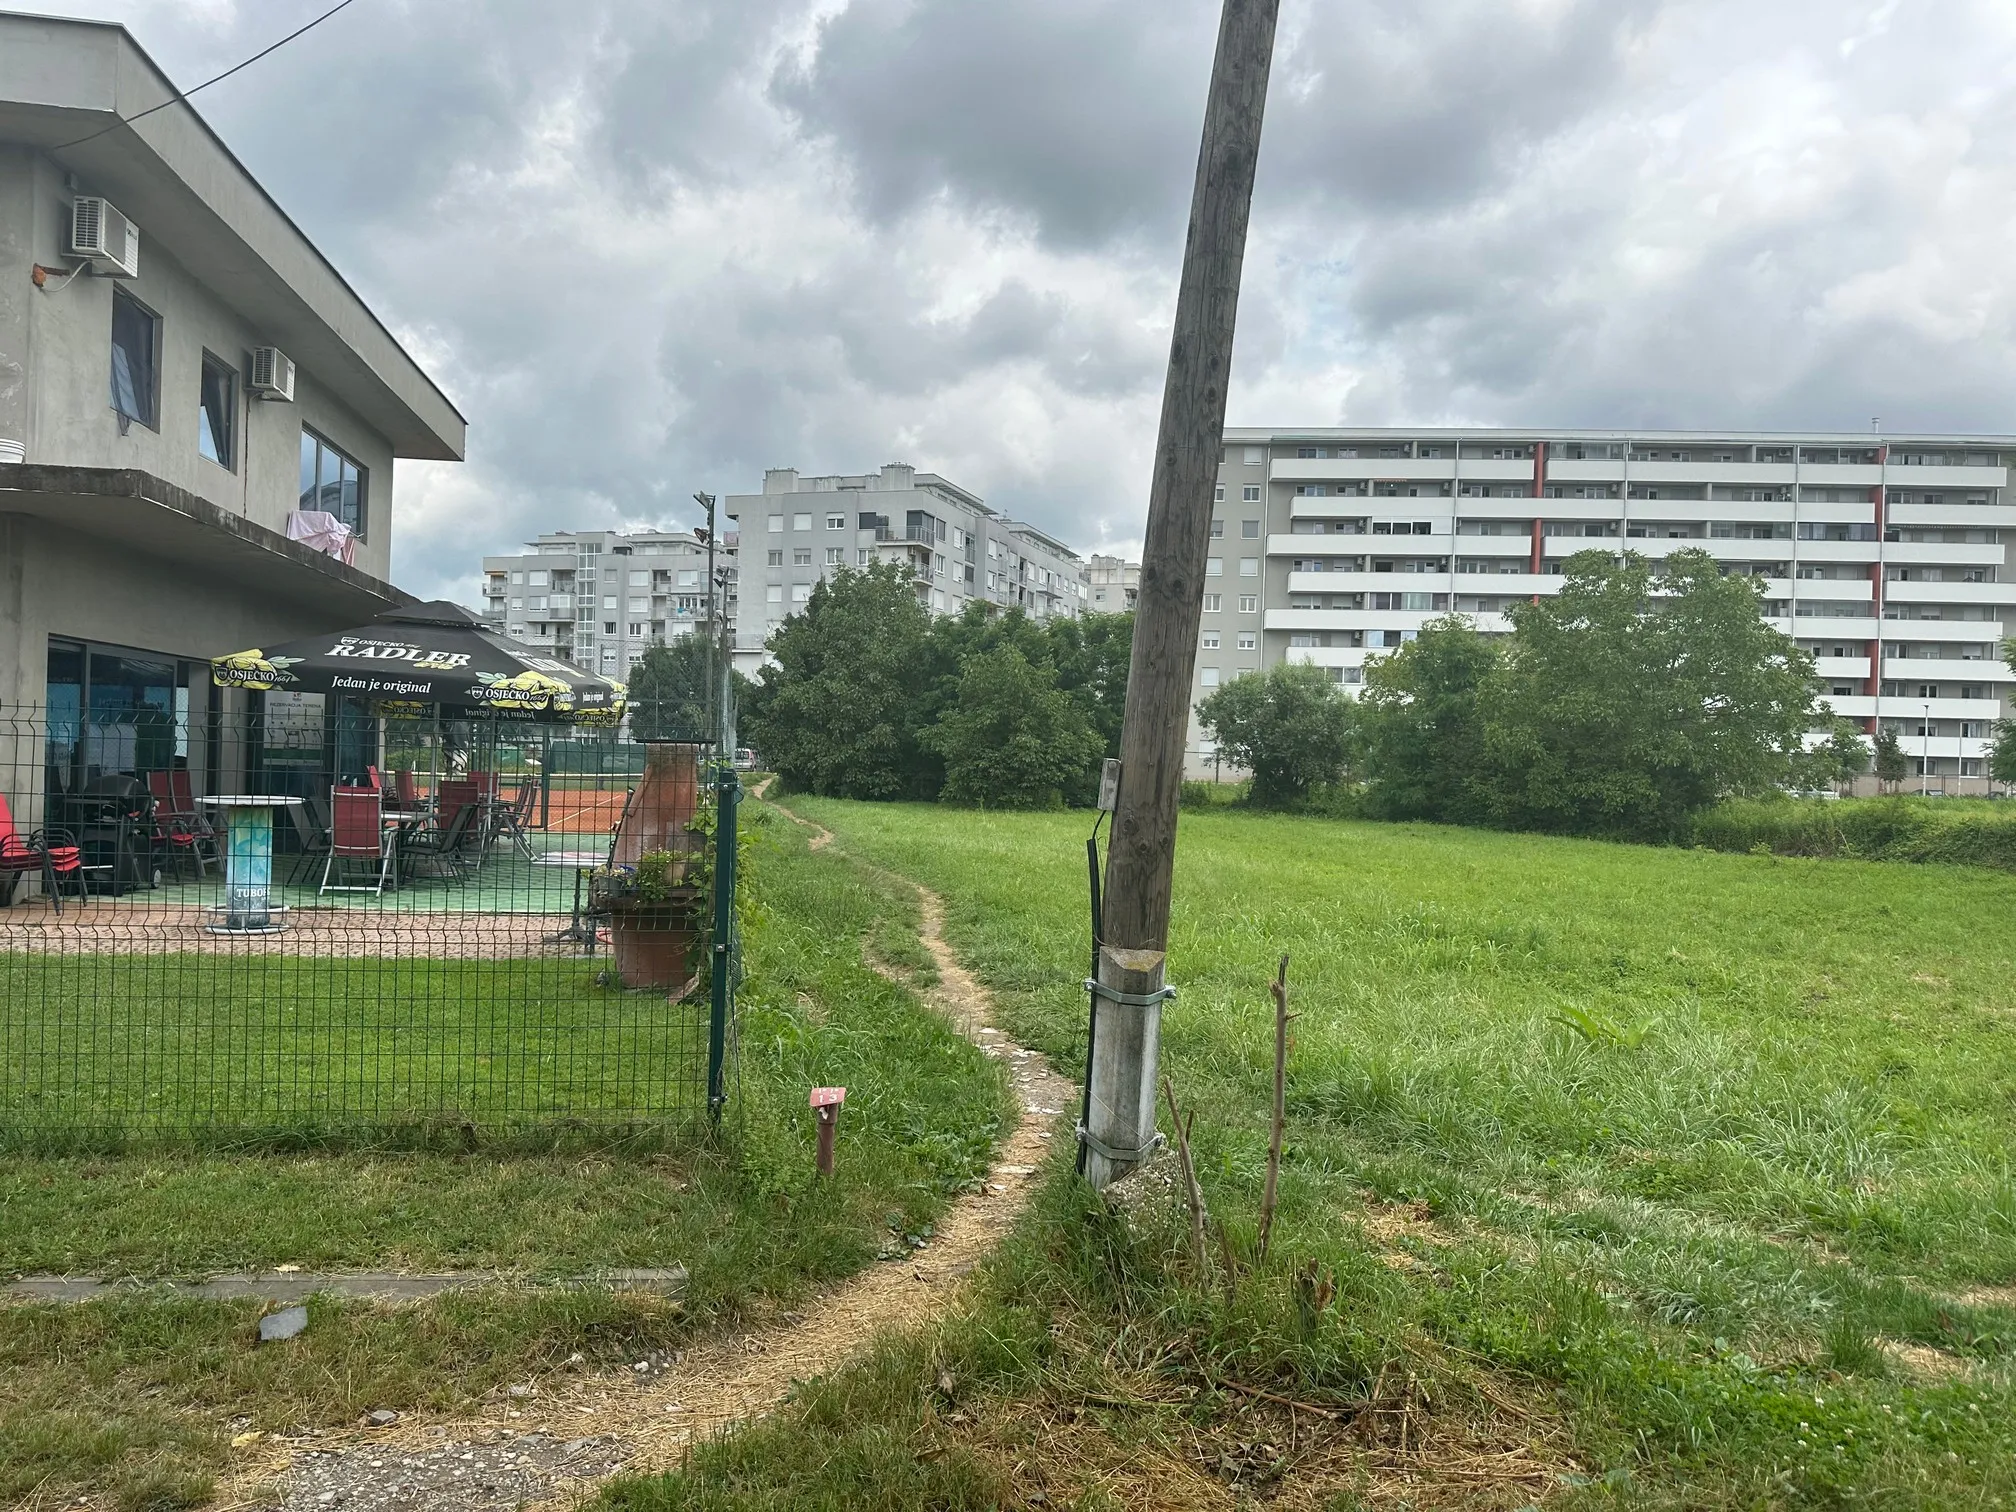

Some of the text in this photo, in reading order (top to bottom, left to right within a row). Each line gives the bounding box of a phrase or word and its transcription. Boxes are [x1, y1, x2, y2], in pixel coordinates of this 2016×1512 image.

[324, 644, 472, 666] RADLER
[332, 675, 432, 694] Jedan je original
